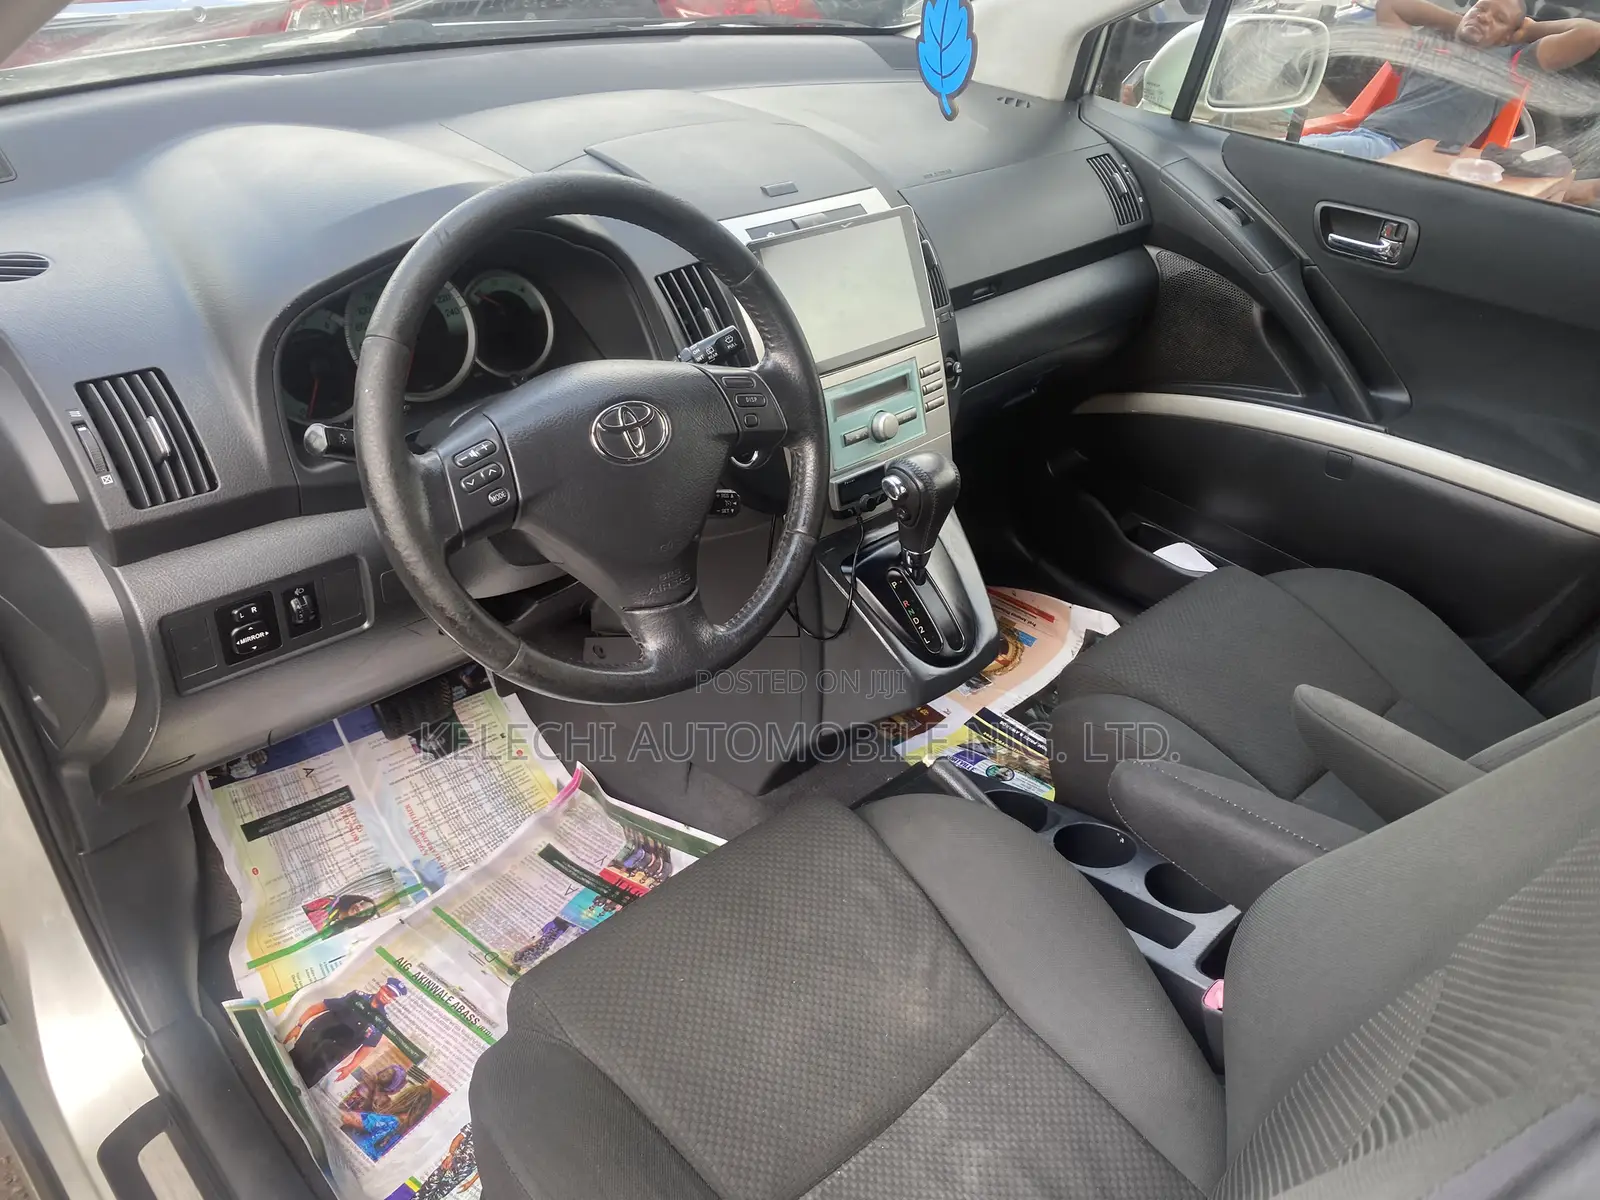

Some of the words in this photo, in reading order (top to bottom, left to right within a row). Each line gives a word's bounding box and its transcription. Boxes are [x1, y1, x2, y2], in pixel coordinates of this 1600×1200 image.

[727, 342, 738, 350] PULL
[489, 491, 507, 503] MODE
[891, 581, 898, 589] P
[903, 600, 910, 608] R
[908, 608, 915, 616] N
[913, 617, 920, 625] D
[918, 626, 925, 634] 2
[240, 631, 265, 645] MIRROR
[396, 956, 413, 972] AIG
[411, 971, 455, 1004] AKINWALE
[450, 1001, 480, 1025] ABASS
